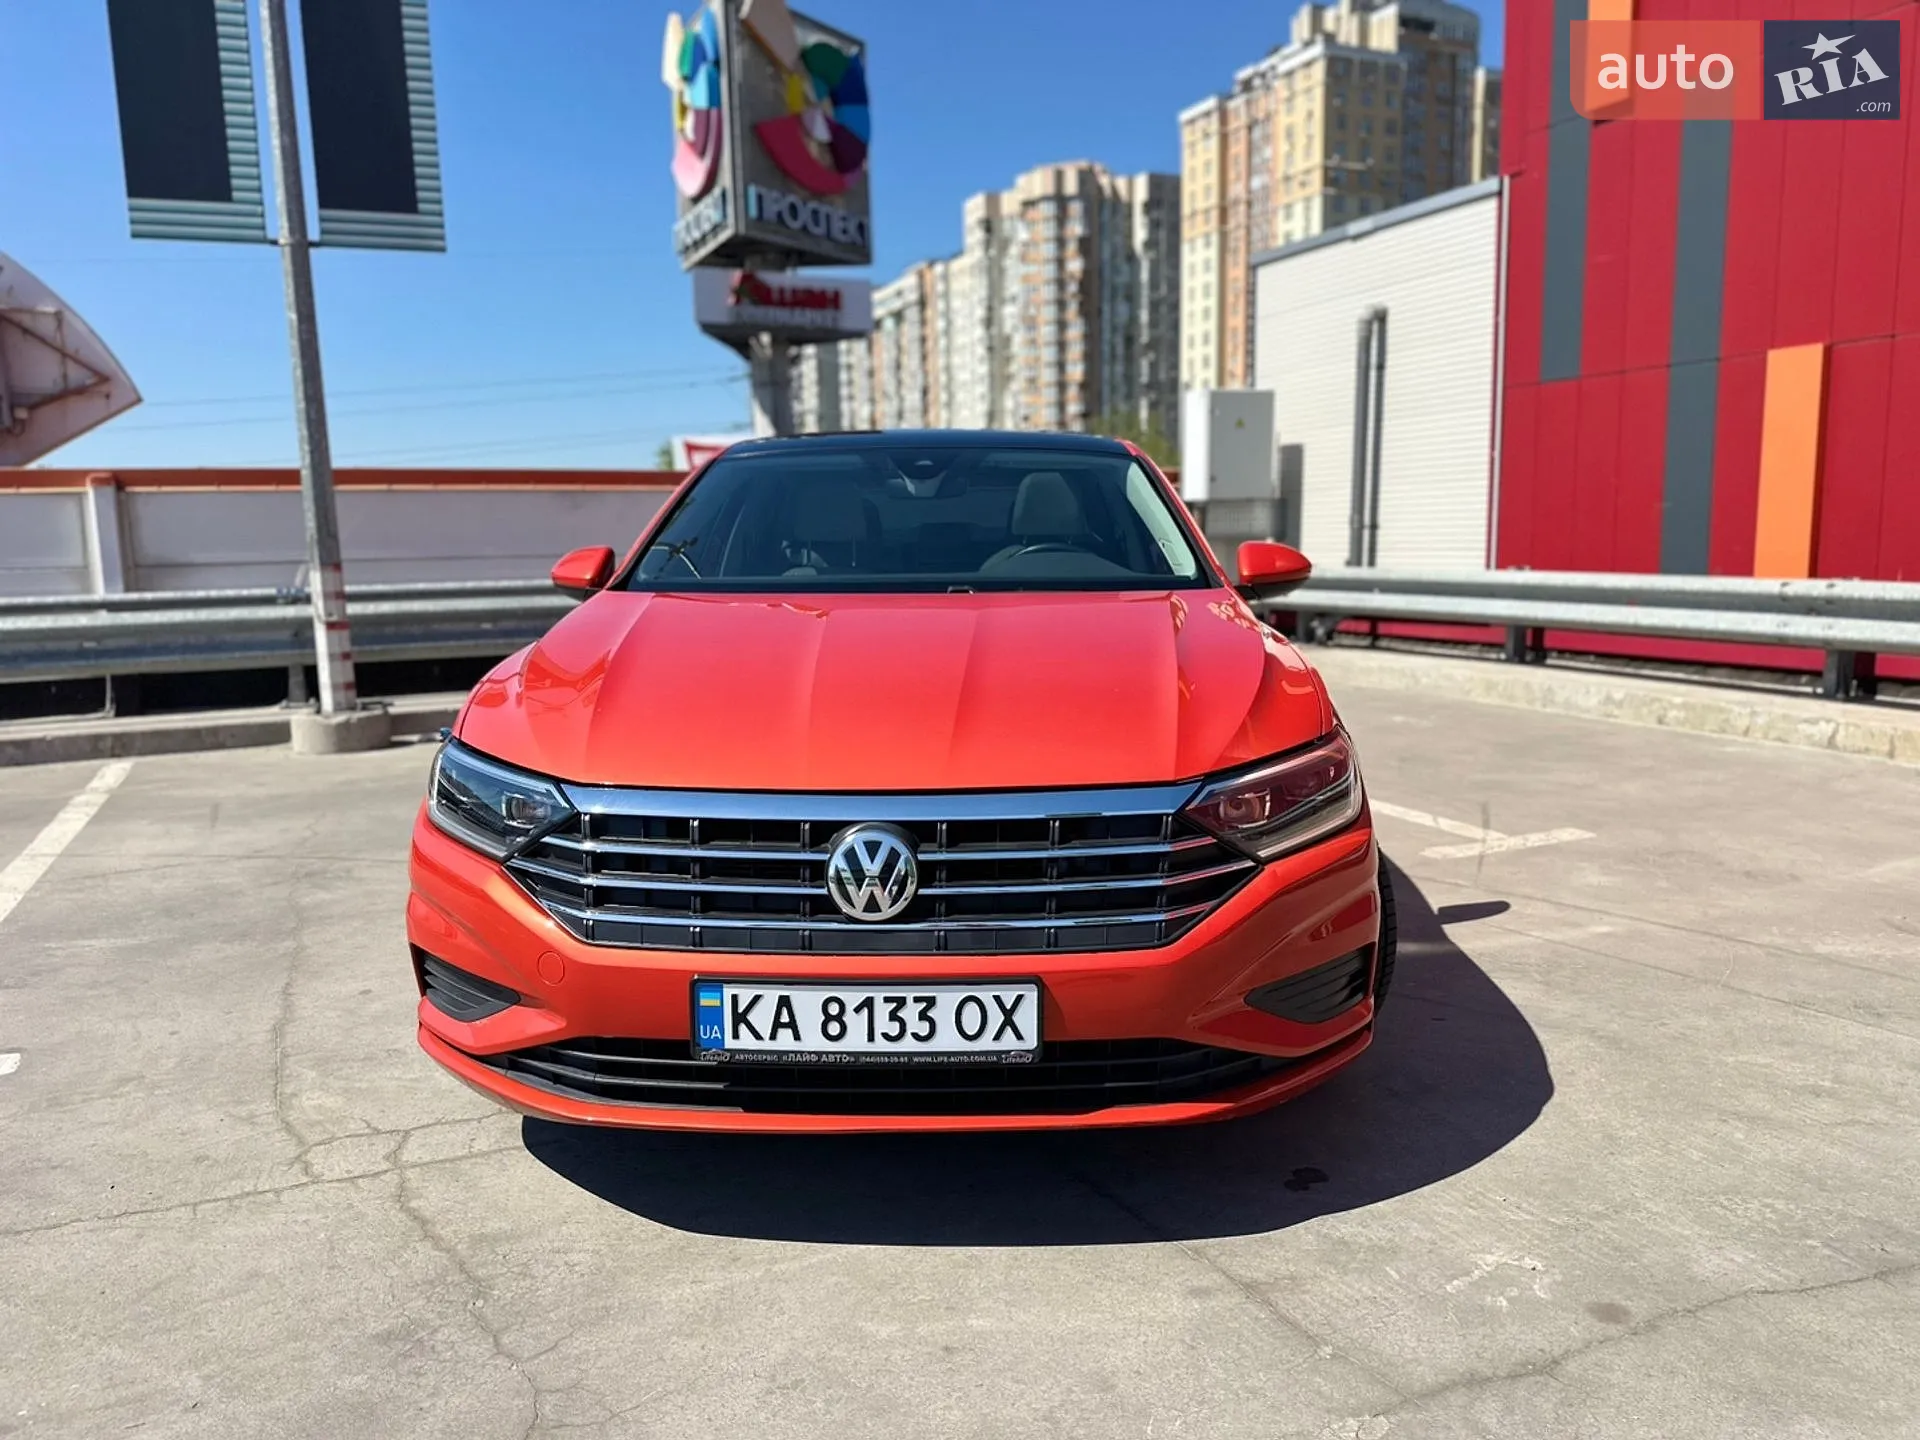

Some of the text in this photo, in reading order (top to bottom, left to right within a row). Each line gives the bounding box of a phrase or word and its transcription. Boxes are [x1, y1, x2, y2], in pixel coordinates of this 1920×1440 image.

[700, 1025, 722, 1040] UA
[731, 993, 1025, 1043] KA 8133 OX
